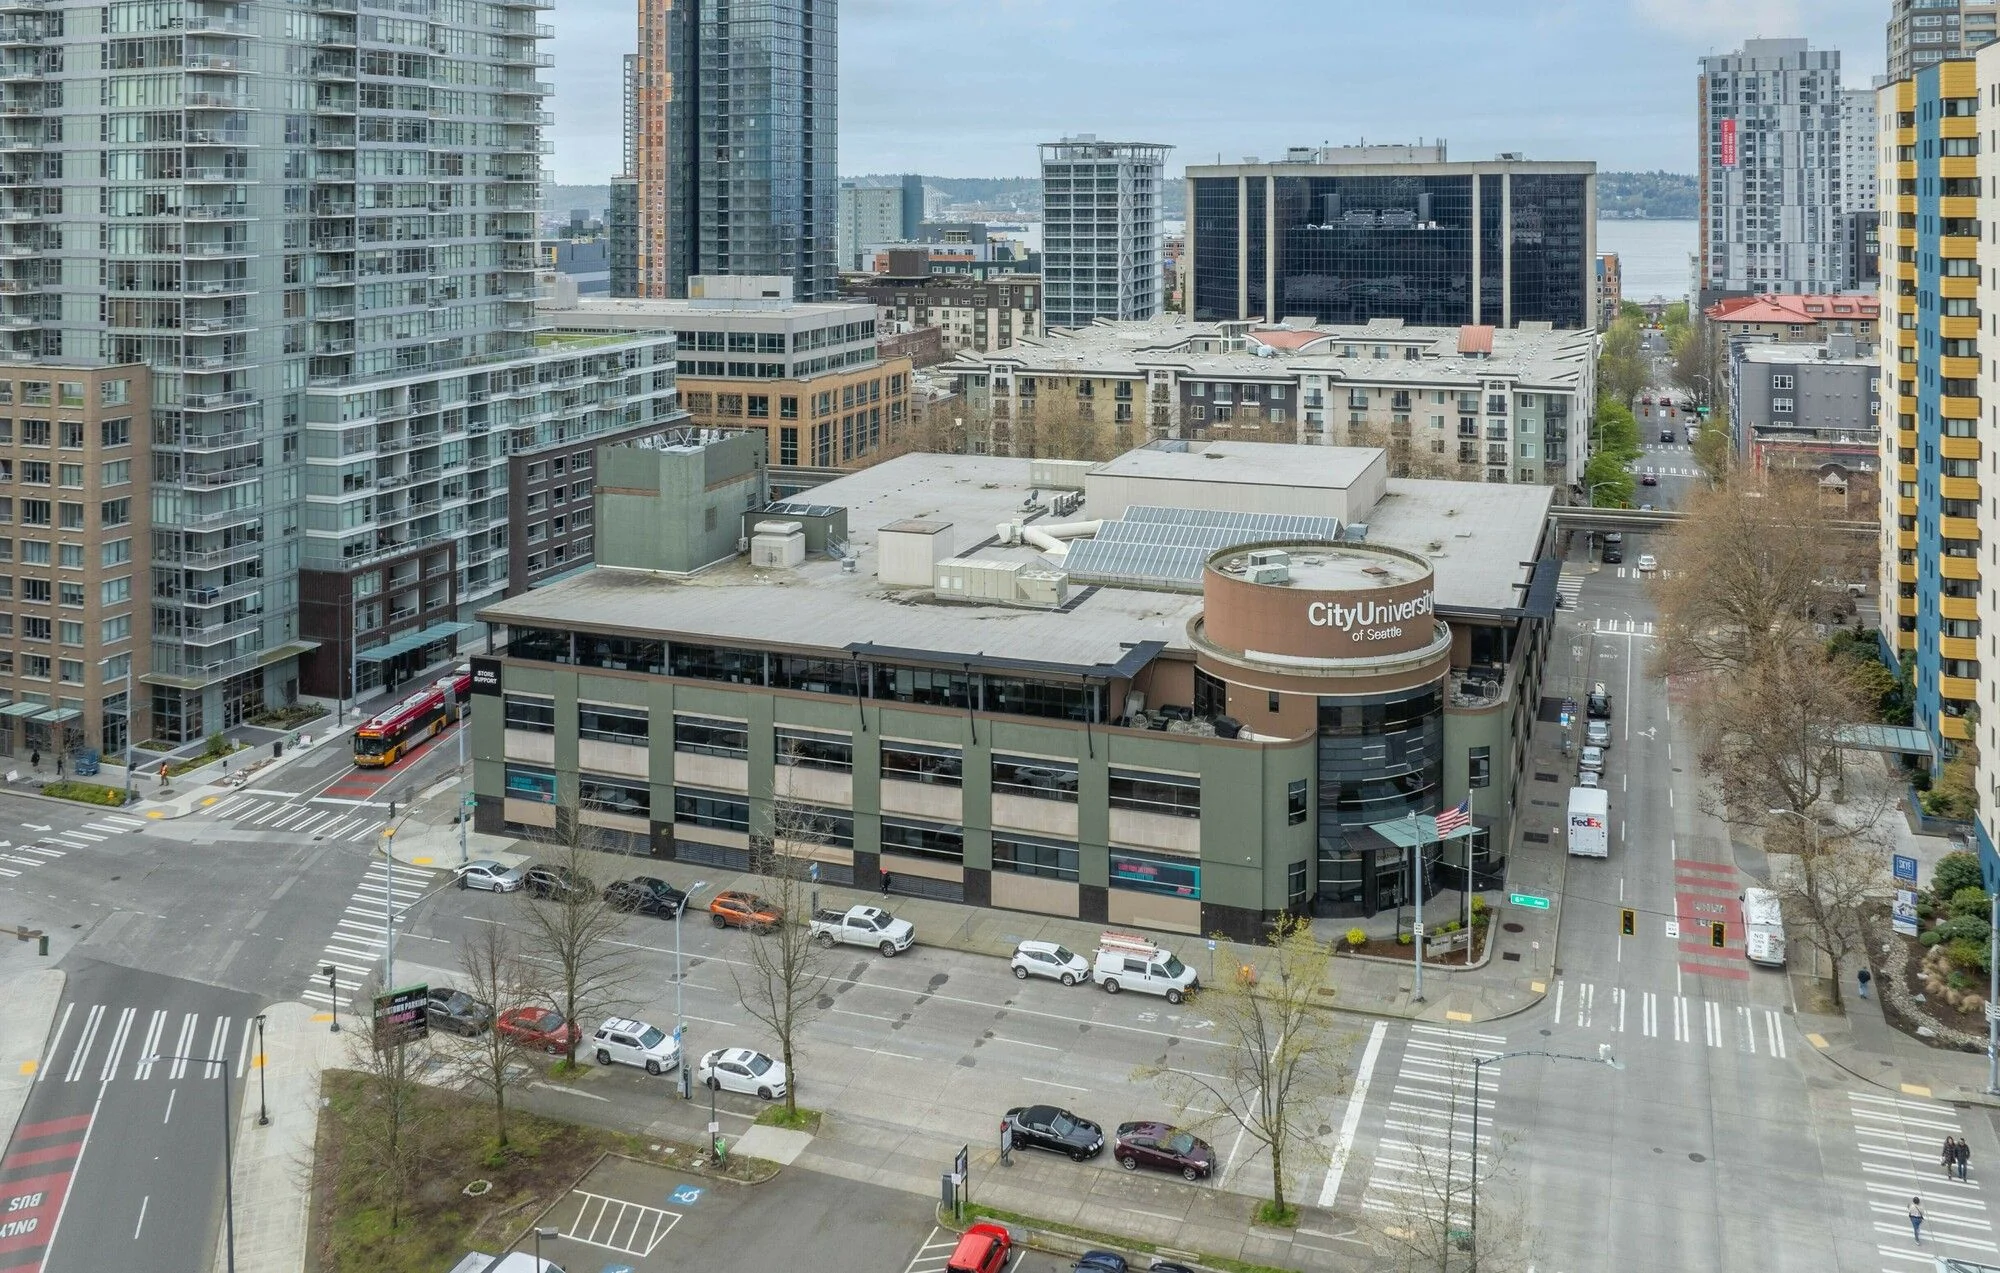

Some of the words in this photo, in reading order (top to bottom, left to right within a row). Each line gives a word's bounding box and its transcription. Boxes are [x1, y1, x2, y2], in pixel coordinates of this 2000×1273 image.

[1308, 589, 1434, 632] CityUniversity
[1352, 629, 1363, 642] of
[1367, 626, 1402, 640] Seattle
[474, 676, 497, 685] SUPPORT
[477, 670, 495, 678] STORE
[1571, 816, 1602, 829] FedEx
[8, 1192, 43, 1212] BUS
[0, 1218, 38, 1238] ONLY
